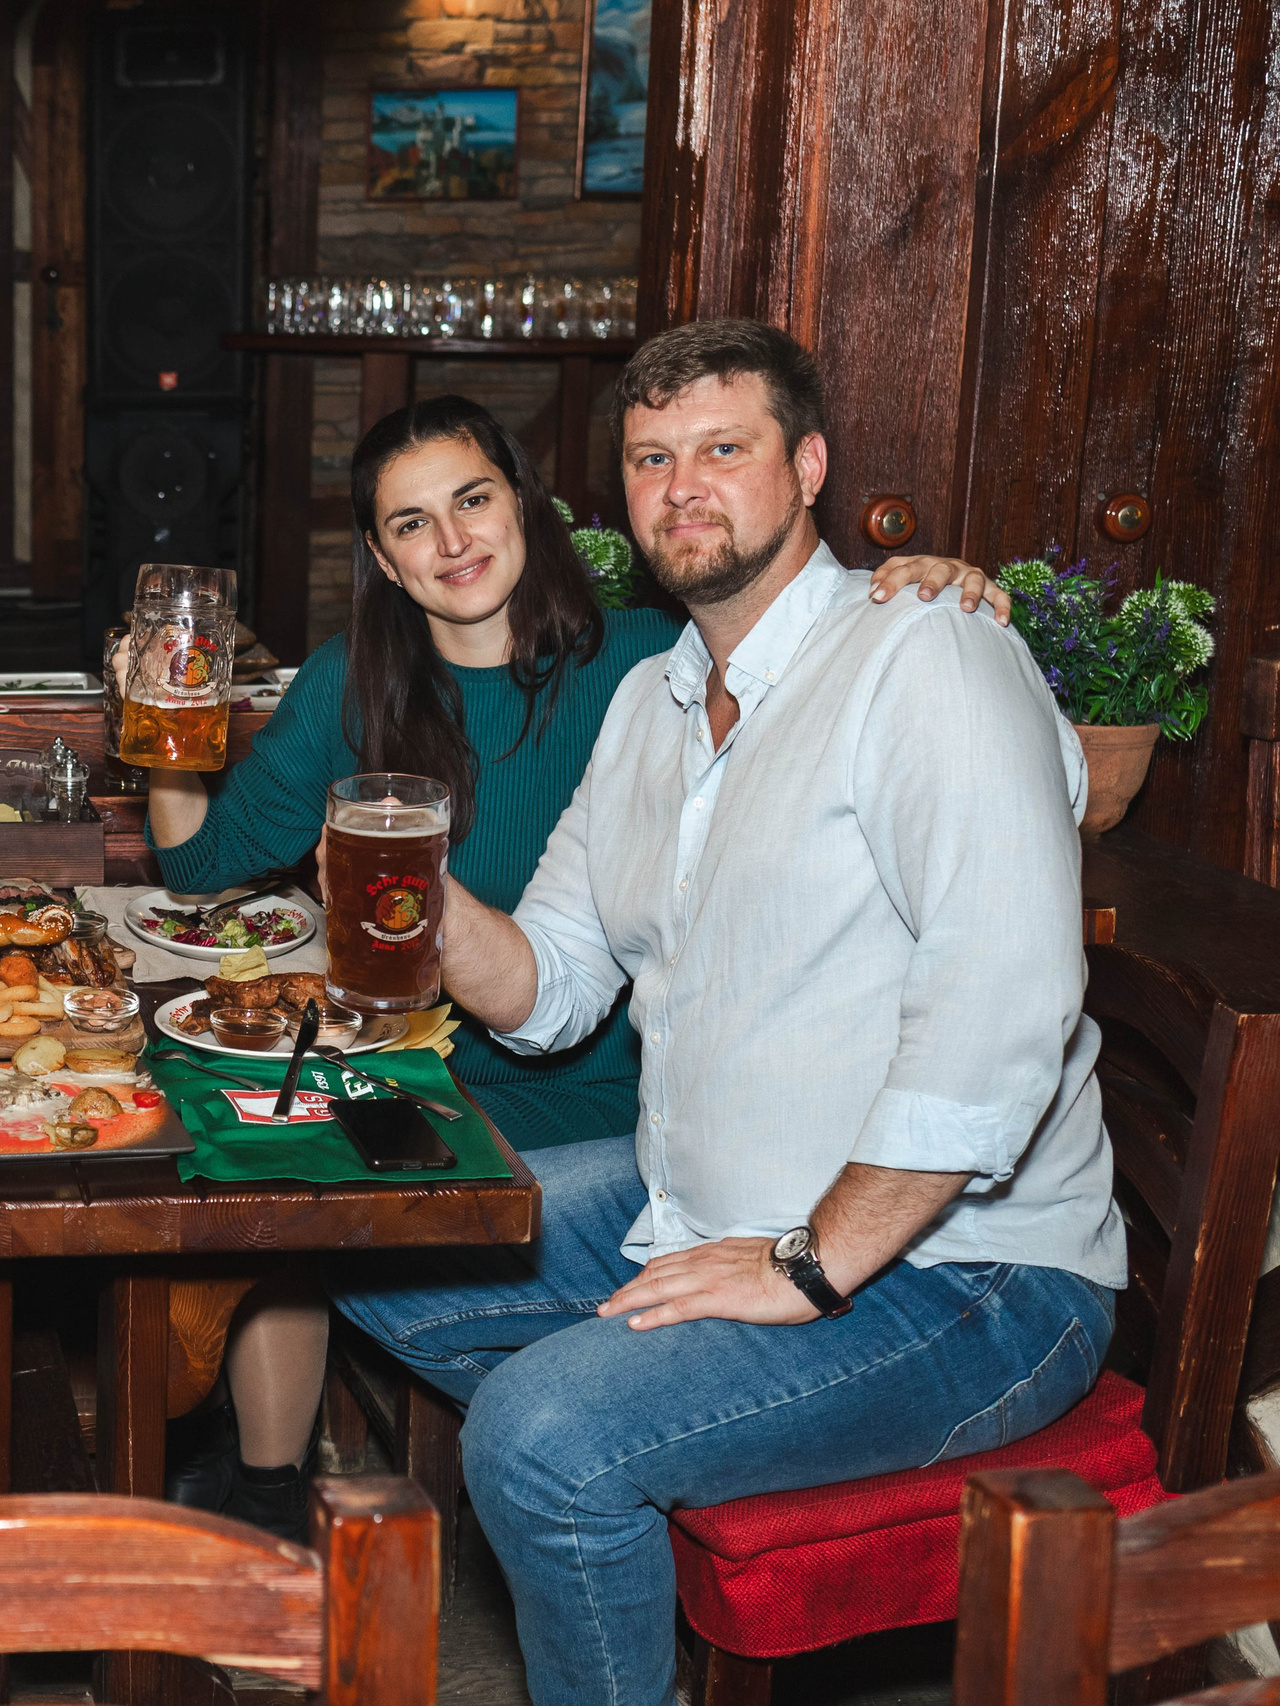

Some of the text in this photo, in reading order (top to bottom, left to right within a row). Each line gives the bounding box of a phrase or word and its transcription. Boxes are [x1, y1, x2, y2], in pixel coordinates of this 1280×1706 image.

[165, 694, 208, 707] Anno 2012
[366, 875, 399, 896] Sehr
[372, 937, 420, 951] Anno 2012
[310, 1070, 331, 1090] 1397
